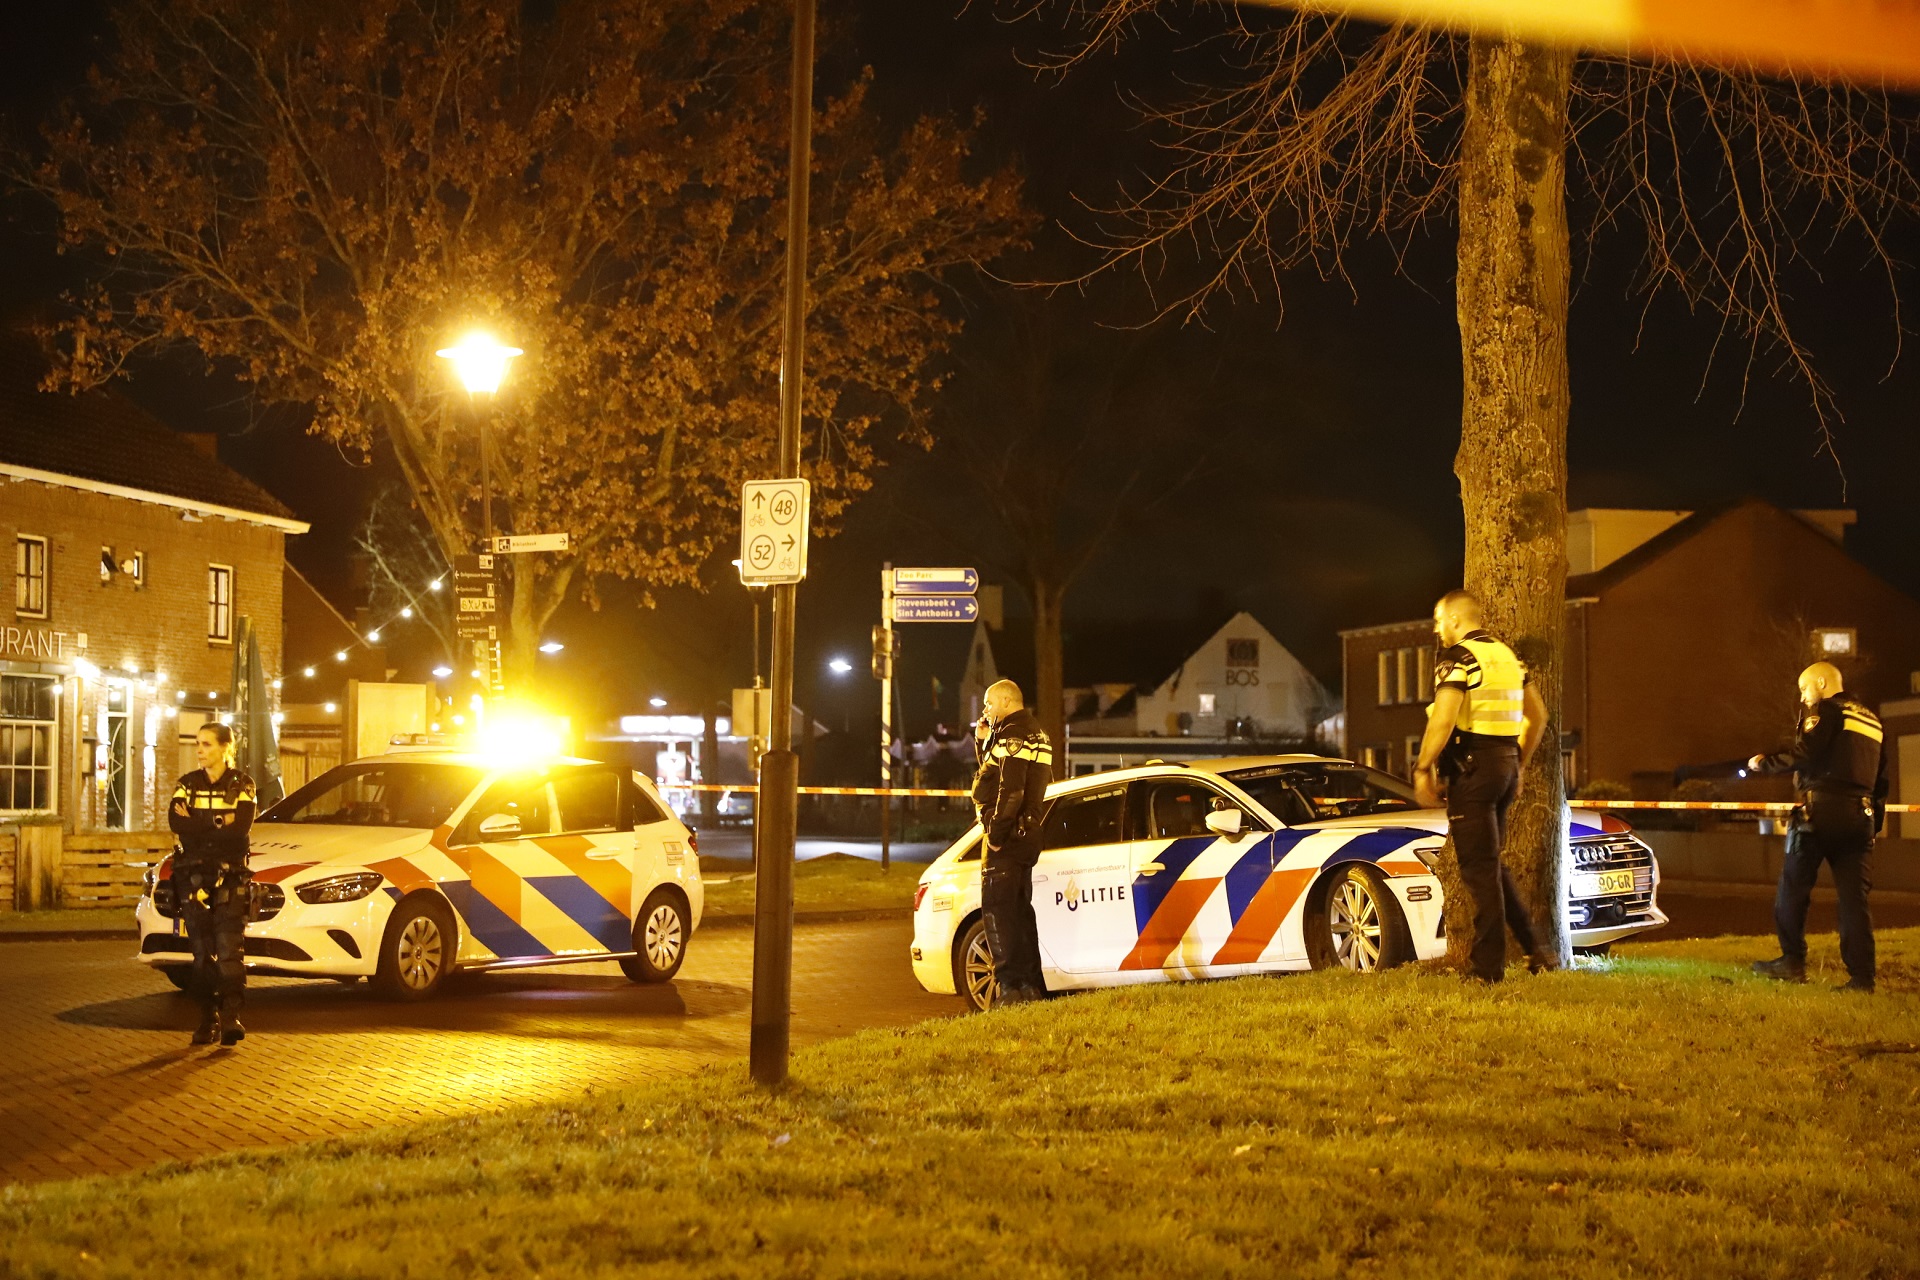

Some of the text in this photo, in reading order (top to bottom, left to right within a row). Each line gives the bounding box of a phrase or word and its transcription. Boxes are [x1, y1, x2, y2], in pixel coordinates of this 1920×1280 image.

[774, 499, 793, 516] 48
[753, 544, 771, 561] 52
[899, 571, 933, 579] Zoo Parc
[897, 599, 956, 607] Stevensbeek 4
[897, 609, 914, 617] Sint
[915, 609, 953, 617] Anthonis
[1226, 669, 1260, 687] BOS
[1055, 886, 1125, 912] POLITIE
